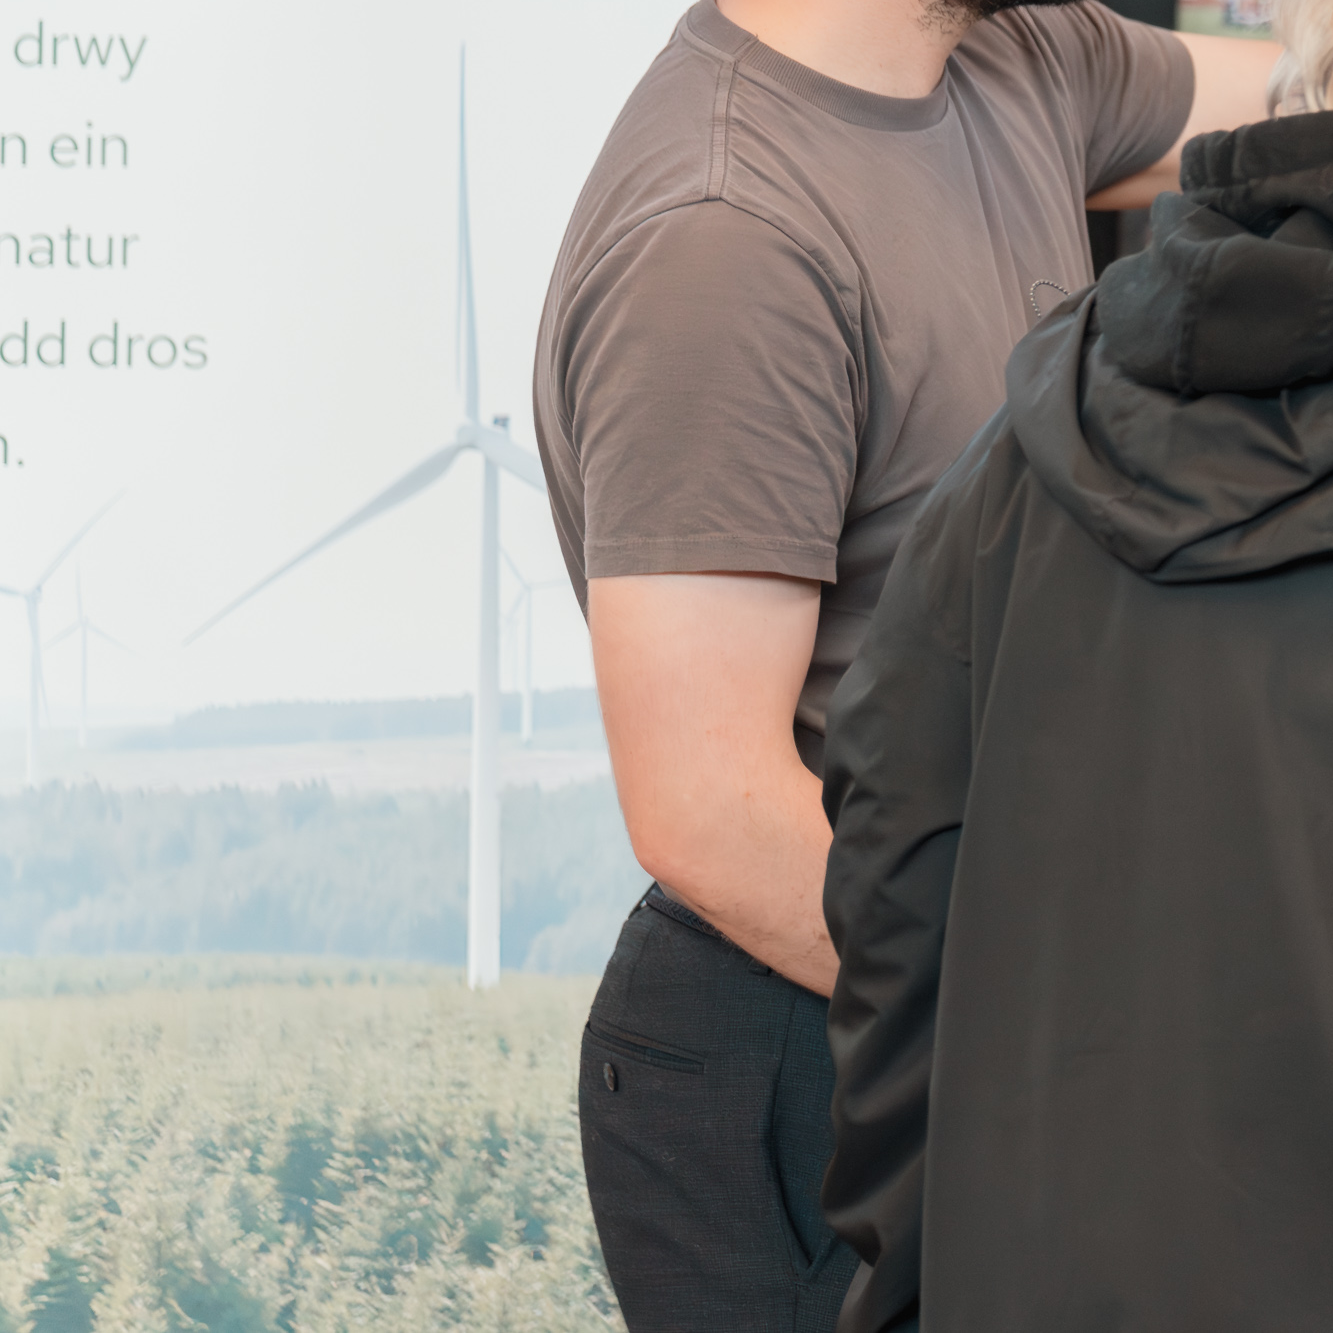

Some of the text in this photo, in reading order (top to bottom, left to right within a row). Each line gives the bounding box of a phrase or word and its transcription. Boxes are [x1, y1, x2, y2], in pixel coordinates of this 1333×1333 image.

[14, 18, 149, 82] drwy
[49, 119, 130, 168] ein
[0, 224, 140, 269] natur
[0, 317, 209, 370] dd dros
